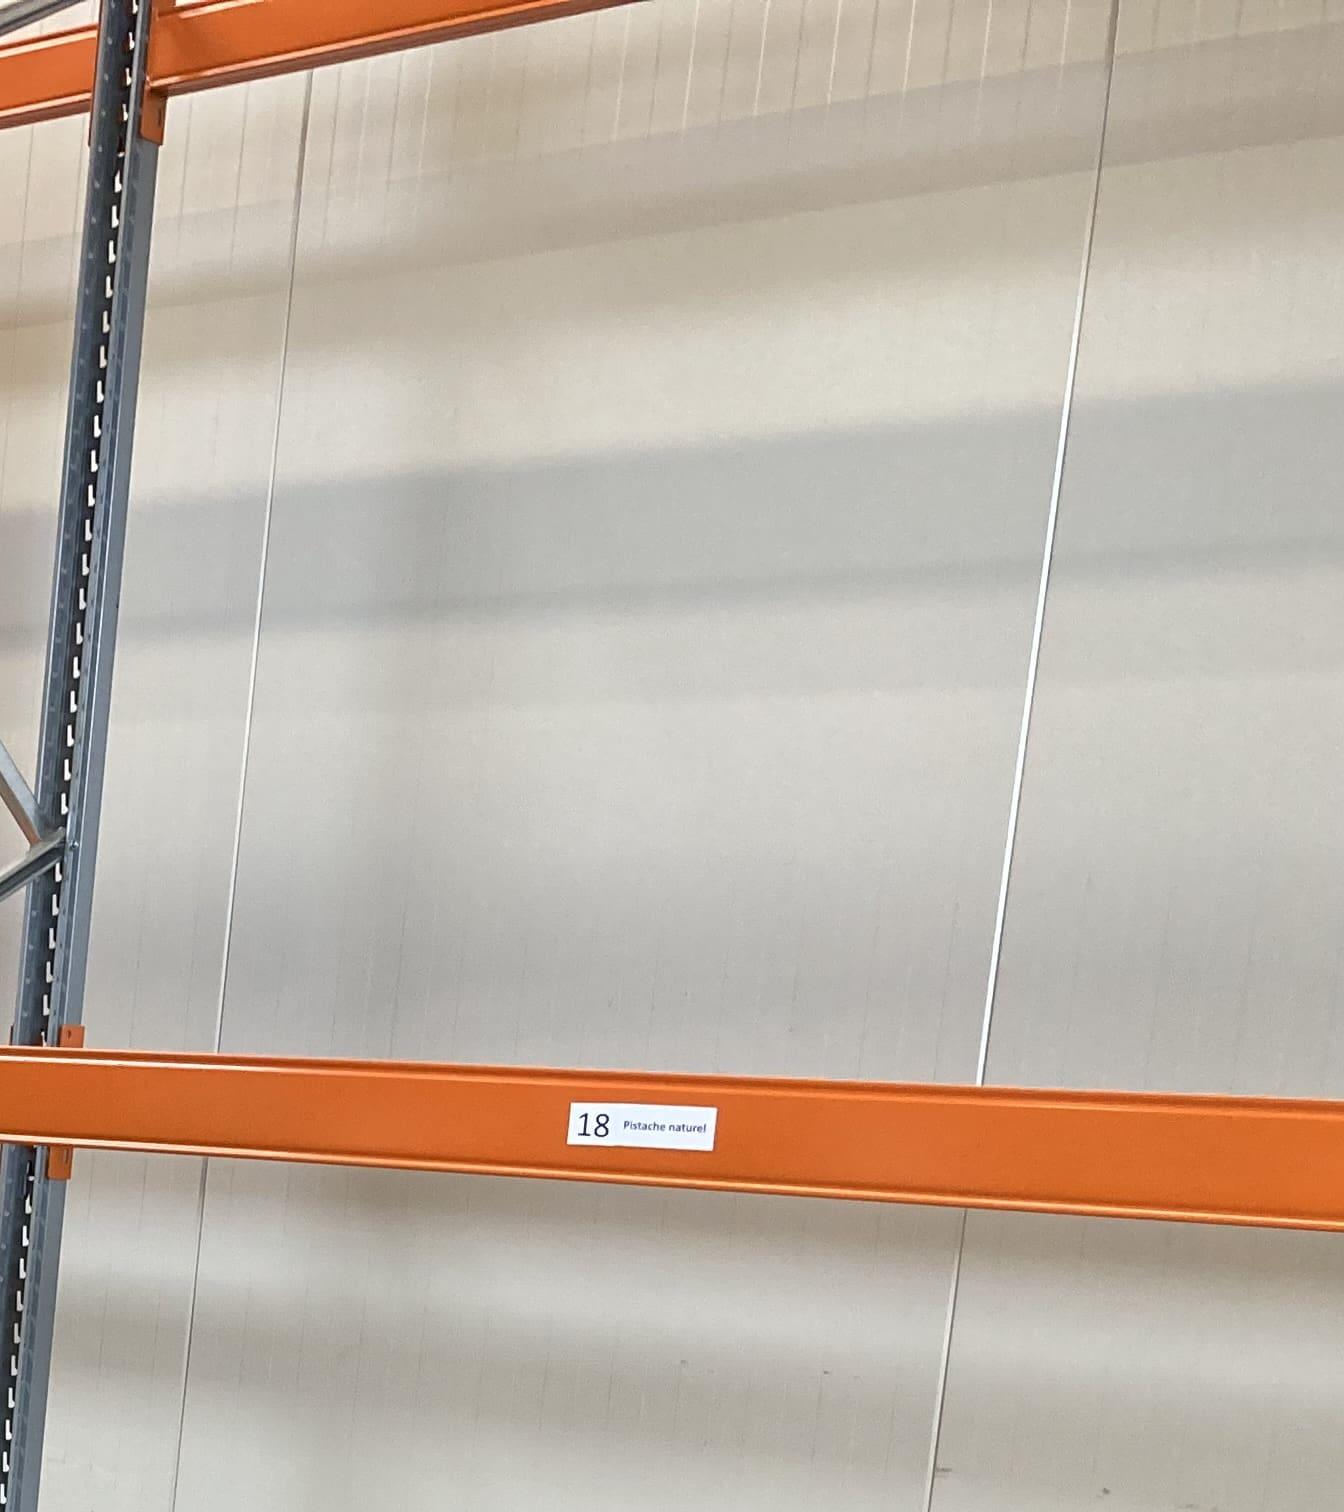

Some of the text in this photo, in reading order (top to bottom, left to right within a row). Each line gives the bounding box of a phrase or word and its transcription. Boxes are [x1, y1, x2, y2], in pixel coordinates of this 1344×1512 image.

[577, 1112, 707, 1138] 18 Pistache naturel
